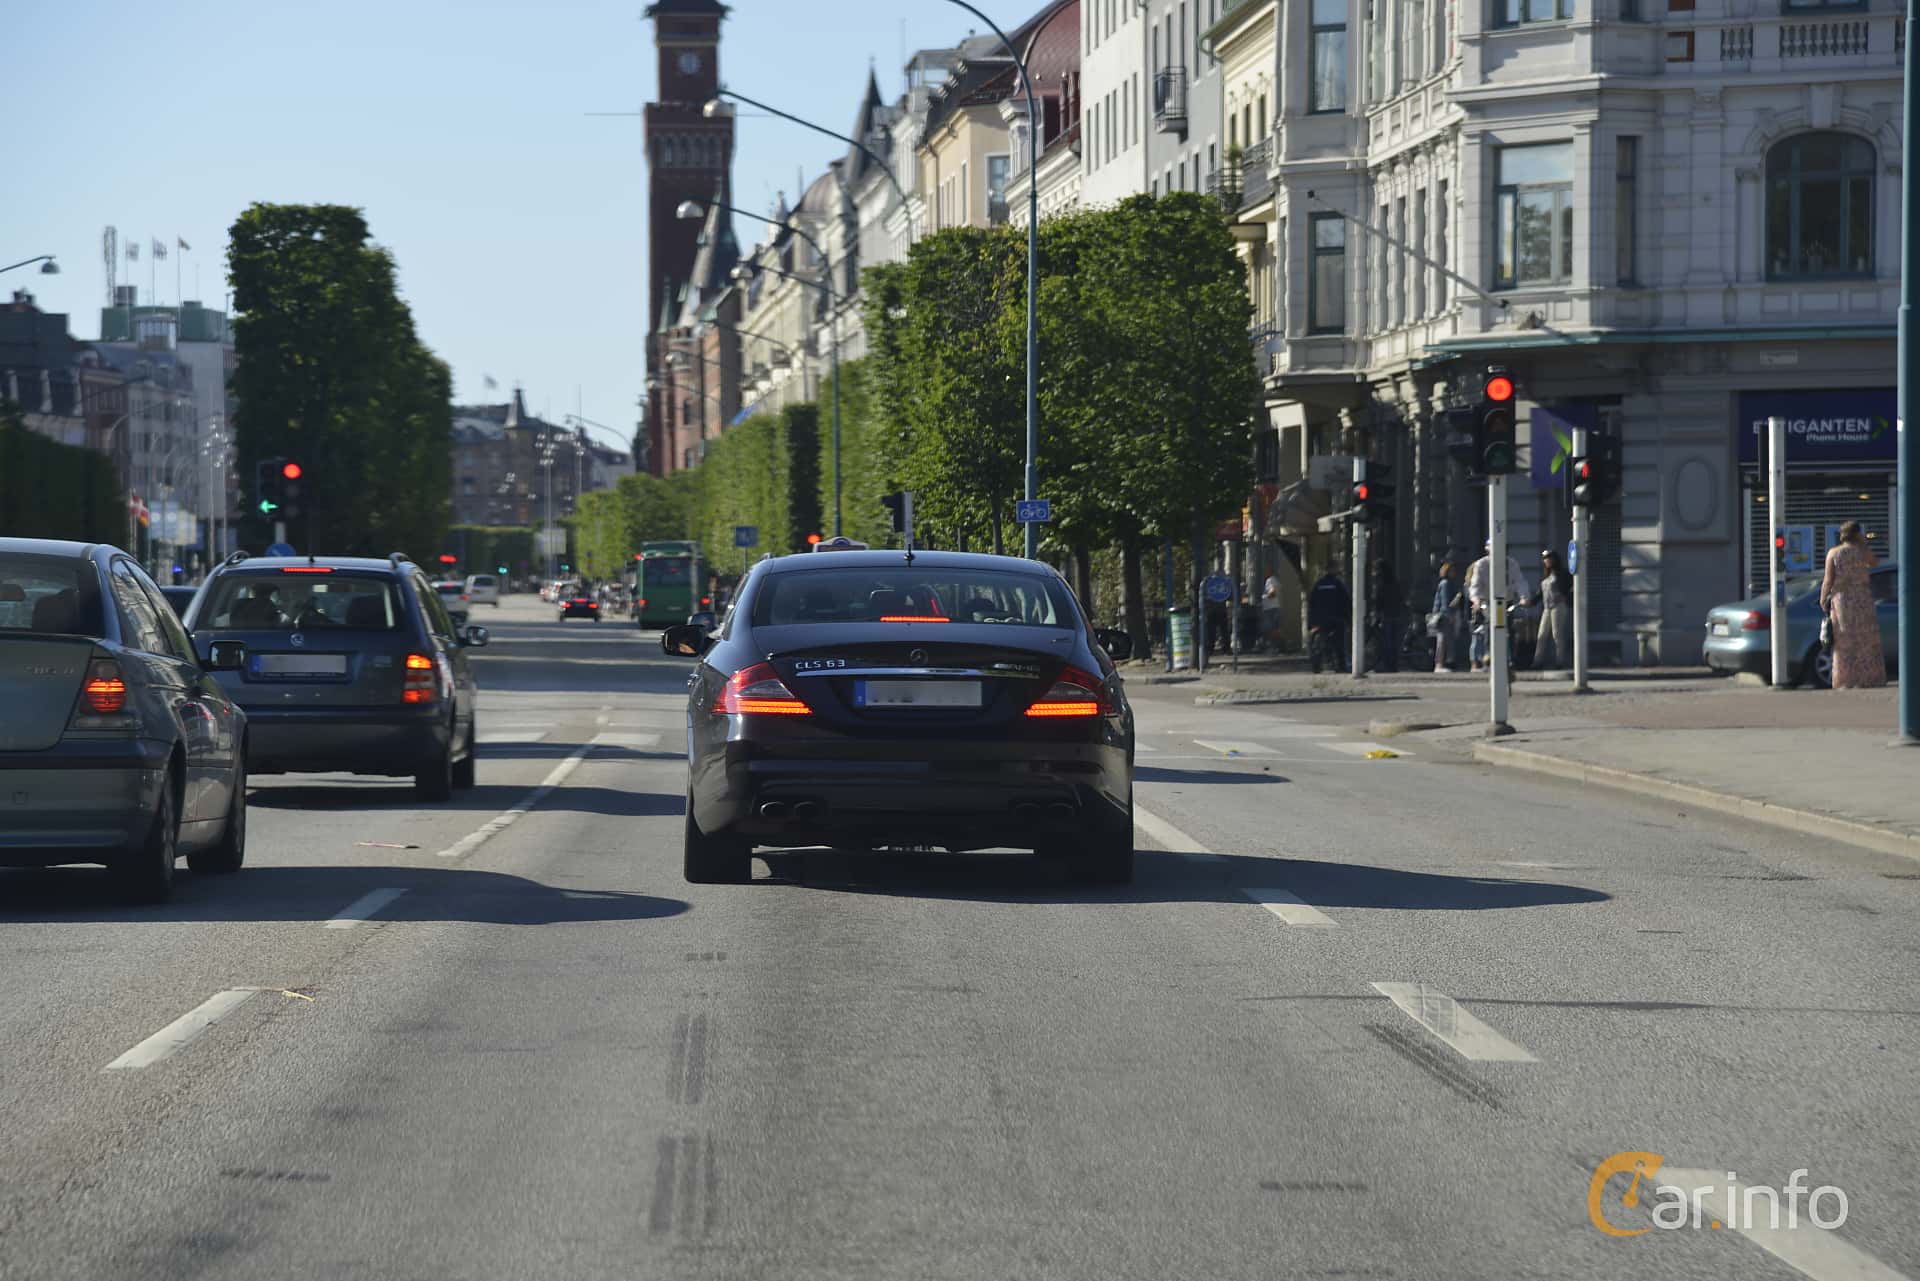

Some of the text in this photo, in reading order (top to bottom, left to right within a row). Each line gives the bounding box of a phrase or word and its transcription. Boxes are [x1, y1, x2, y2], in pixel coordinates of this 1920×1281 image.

[1753, 418, 1870, 434] EIGANTEN
[795, 659, 845, 669] CLS 63
